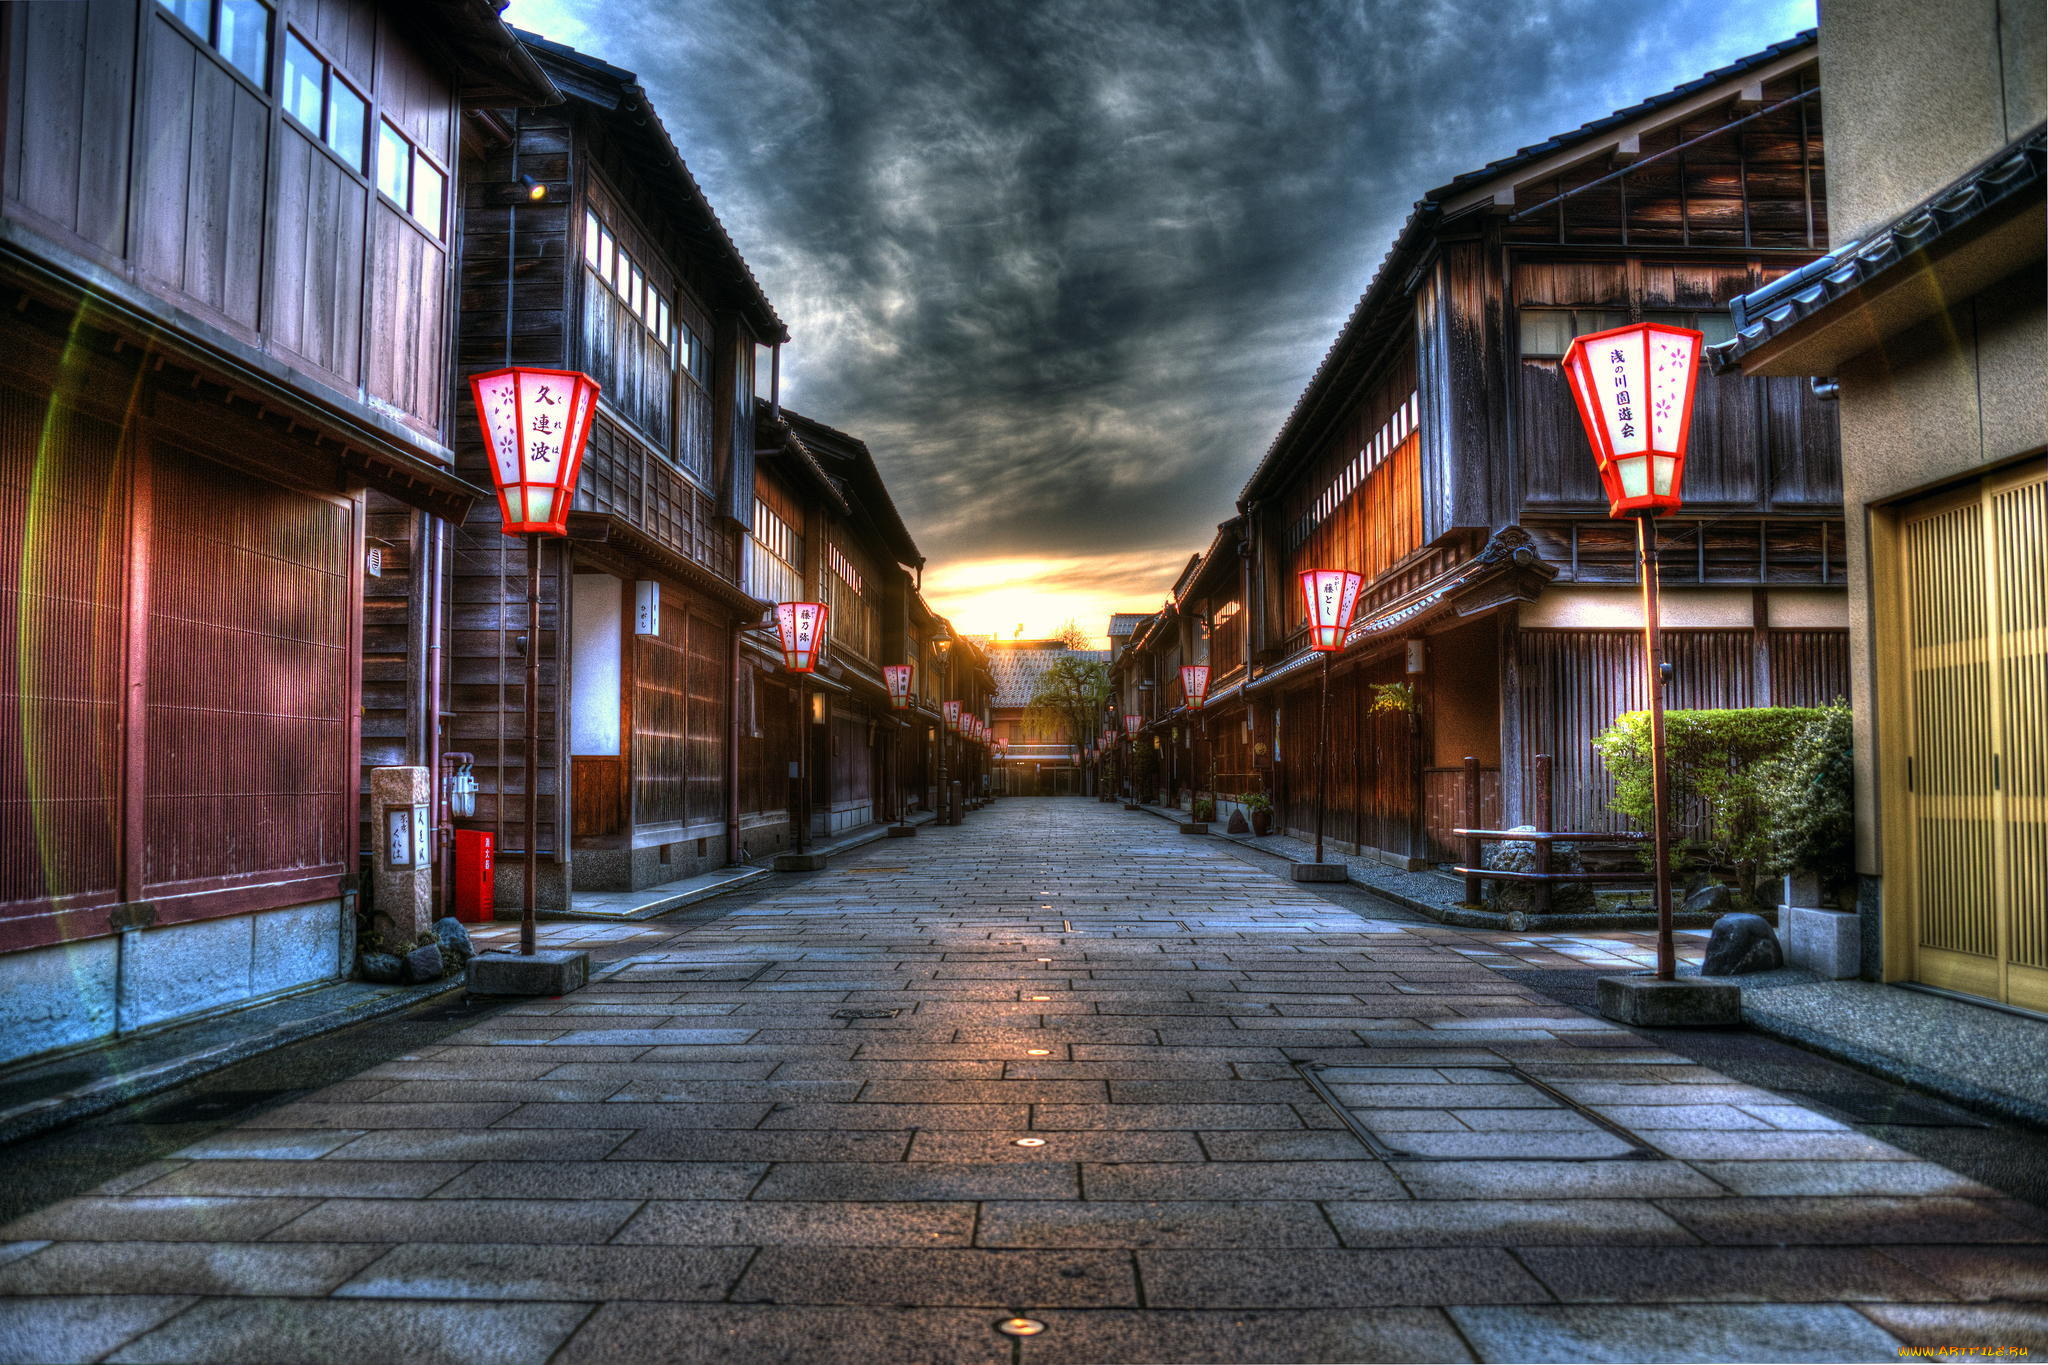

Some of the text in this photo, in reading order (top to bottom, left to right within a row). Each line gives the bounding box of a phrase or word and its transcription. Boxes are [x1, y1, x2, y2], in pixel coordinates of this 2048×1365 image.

[1610, 349, 1635, 438] 浅の川園遊会
[530, 385, 555, 463] 久連波
[551, 396, 562, 455] くれは
[800, 609, 811, 642] 藤乃弥
[1324, 583, 1334, 616] 藤とし
